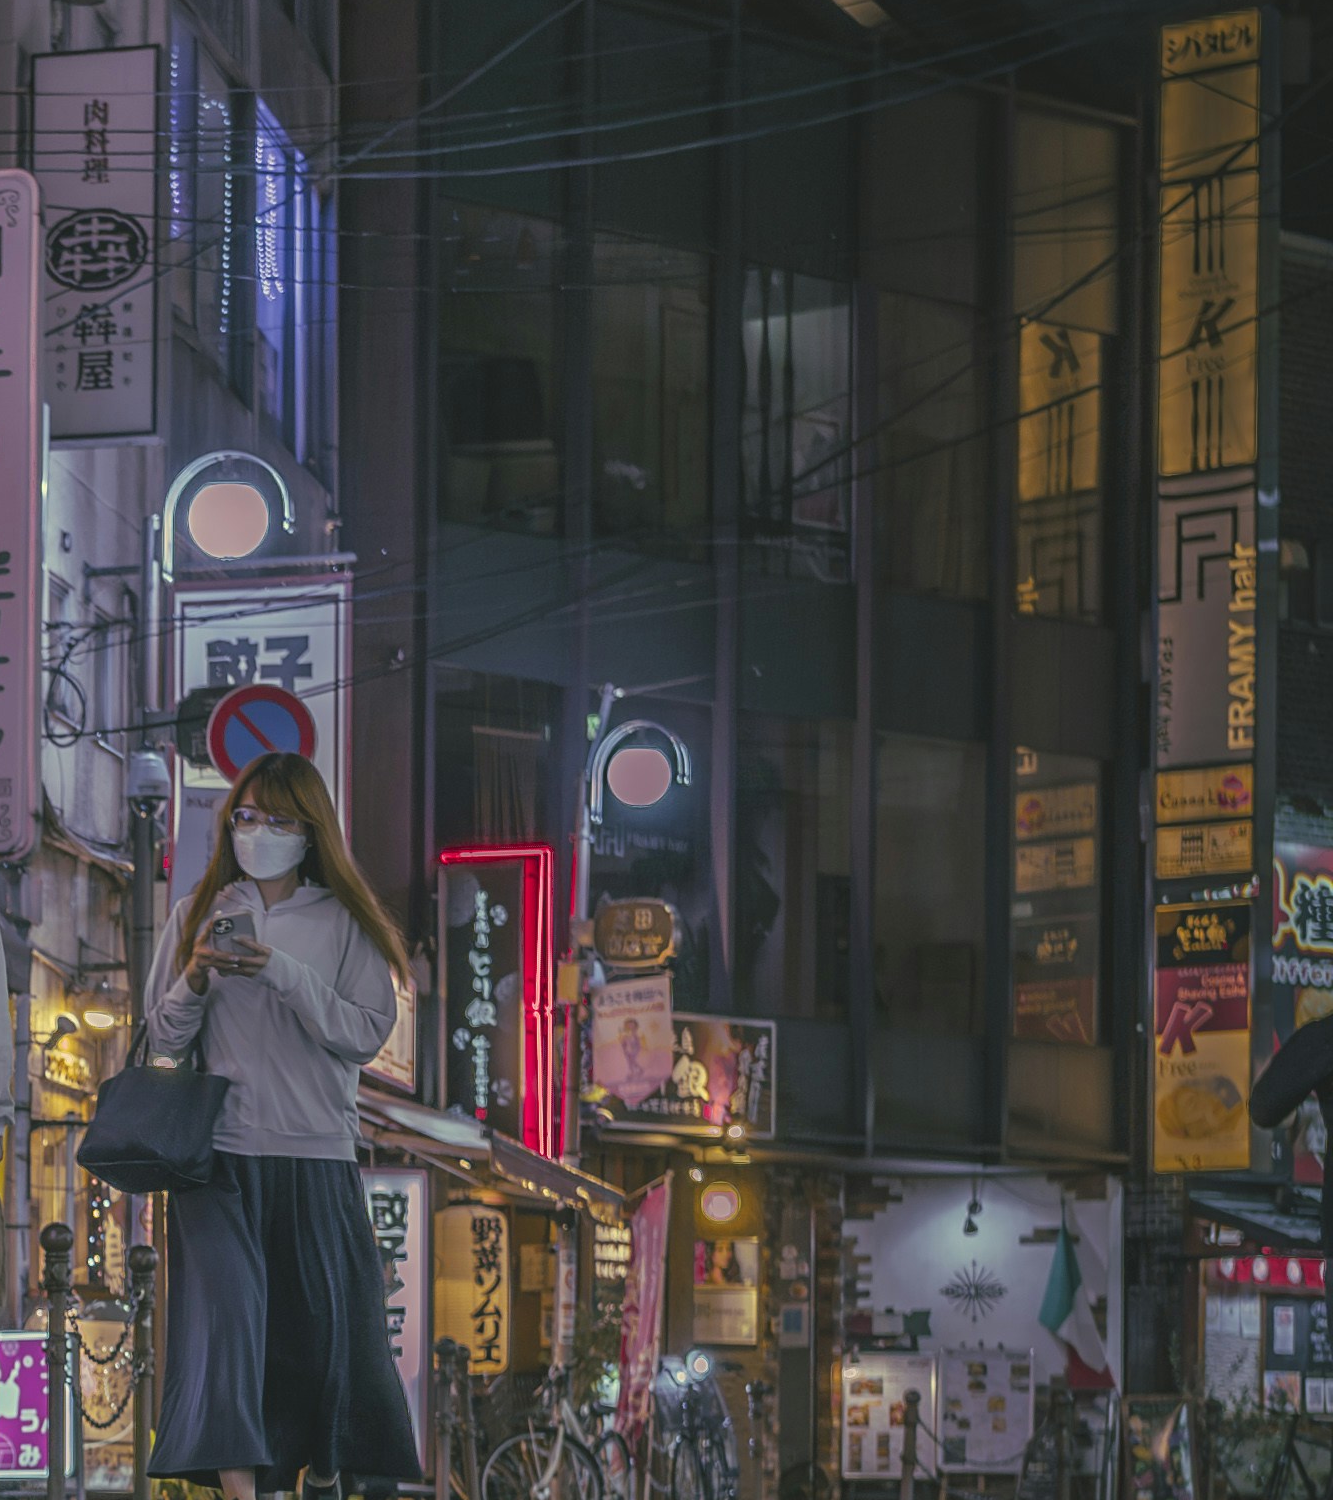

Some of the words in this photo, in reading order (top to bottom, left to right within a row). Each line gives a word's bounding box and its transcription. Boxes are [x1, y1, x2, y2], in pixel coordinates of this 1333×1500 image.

[82, 99, 110, 184] 肉料理
[1229, 543, 1257, 614] hair
[1227, 620, 1256, 751] FRAMY
[471, 1216, 502, 1364] 野菜ソムリエ
